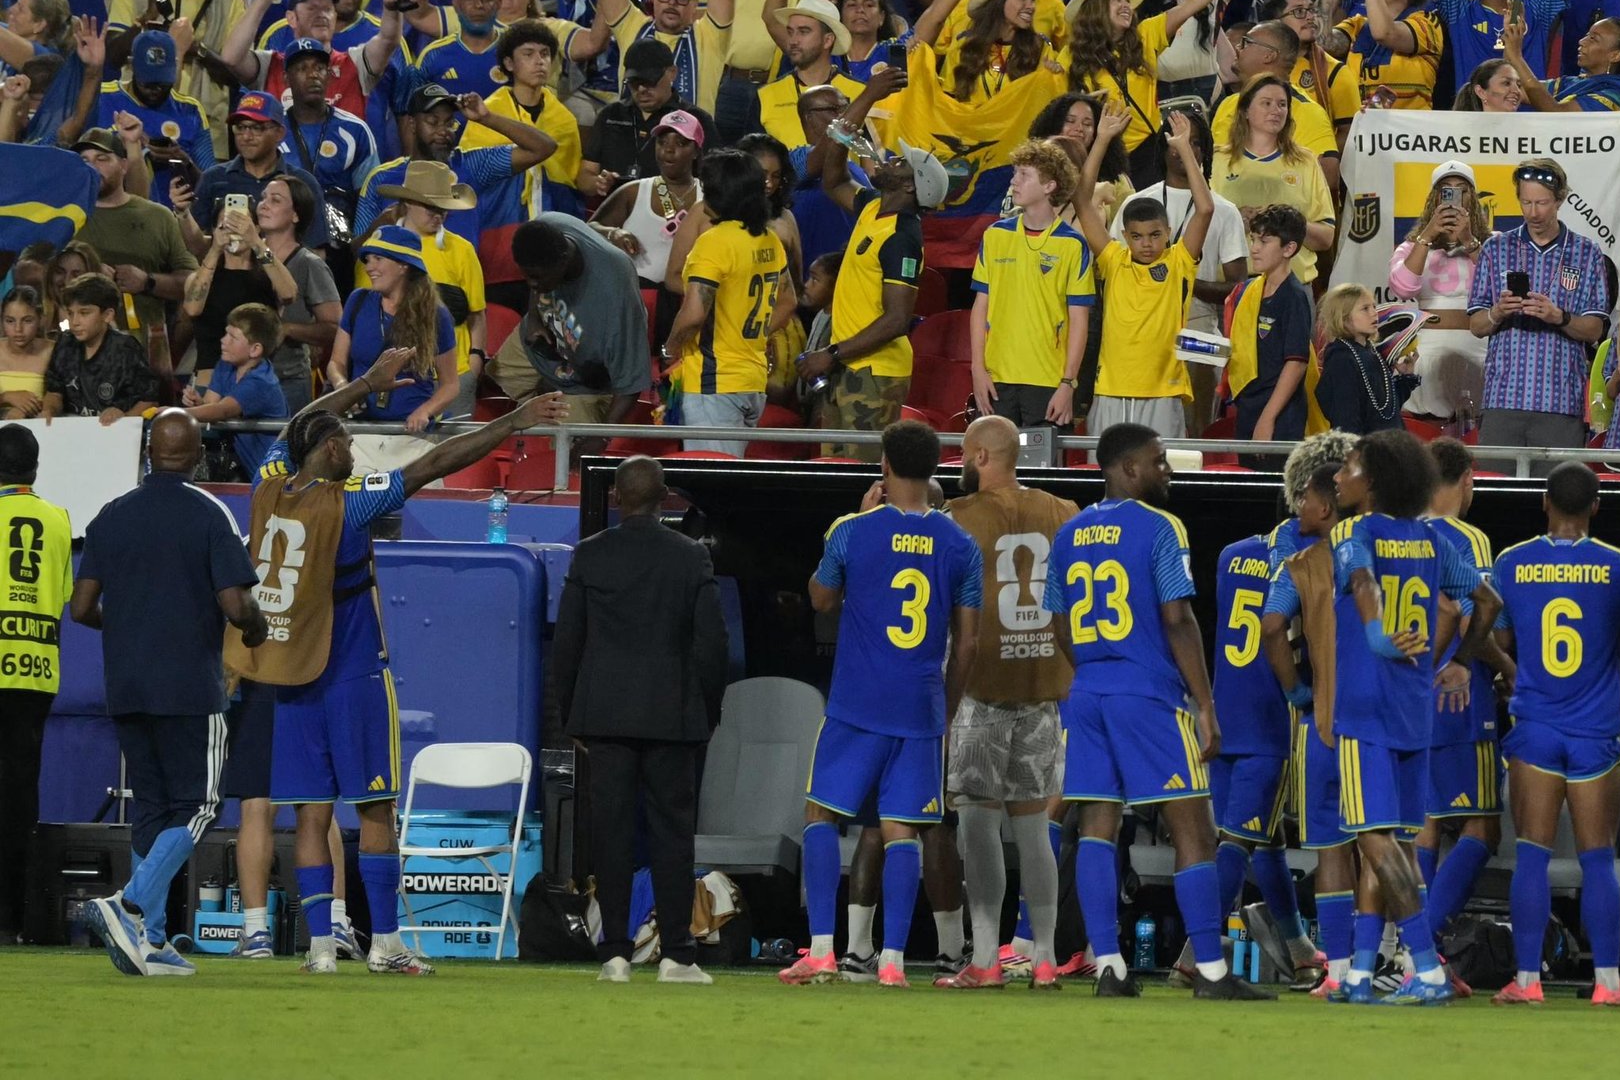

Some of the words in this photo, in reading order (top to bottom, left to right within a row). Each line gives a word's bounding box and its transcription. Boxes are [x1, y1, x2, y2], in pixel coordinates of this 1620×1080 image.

[1367, 133, 1471, 156] JUGARAS
[1479, 136, 1509, 154] EN
[1518, 137, 1542, 154] EL
[1550, 135, 1616, 155] CIELO
[1565, 192, 1616, 250] CUADOR
[1562, 272, 1578, 281] USA
[892, 533, 934, 556] GAARI
[1073, 525, 1121, 547] BAZOER
[8, 593, 38, 605] 2026
[258, 591, 283, 605] FIFA
[886, 567, 931, 650] 3
[1065, 559, 1134, 646] 23
[1015, 610, 1040, 622] FIFA
[1380, 575, 1431, 651] 16
[1224, 587, 1264, 668] 5
[1541, 597, 1583, 678] 6
[1000, 643, 1055, 659] 2026
[0, 652, 53, 681] 6998
[440, 837, 475, 849] CUW
[202, 925, 242, 939] POWER
[443, 932, 473, 945] ADE
